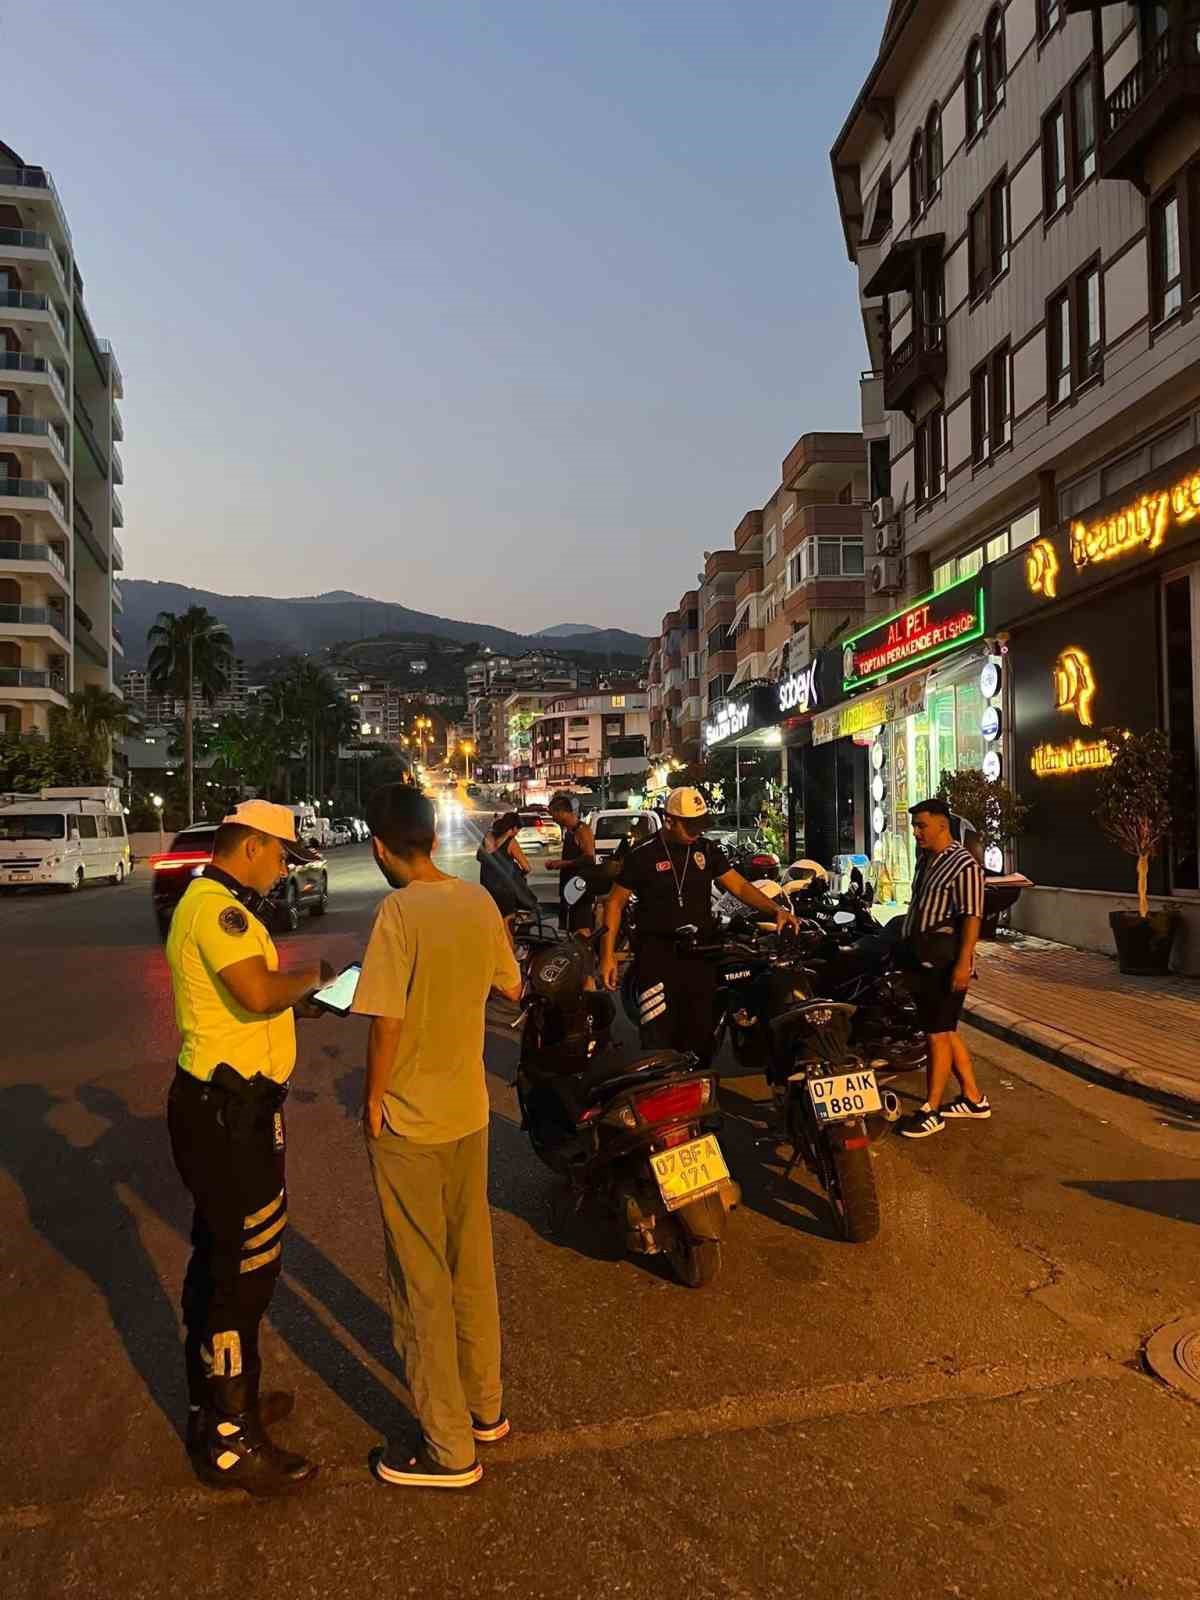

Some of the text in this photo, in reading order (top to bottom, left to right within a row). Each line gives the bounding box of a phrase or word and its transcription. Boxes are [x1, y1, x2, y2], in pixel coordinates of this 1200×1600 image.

[887, 605, 930, 645] AL PET
[859, 653, 887, 676] TOPTAN
[886, 630, 932, 665] PERAKENDE
[949, 614, 975, 639] SHOP
[813, 1074, 874, 1097] 07 AIK
[830, 1094, 864, 1114] 880
[656, 1140, 716, 1175] 07 BFA
